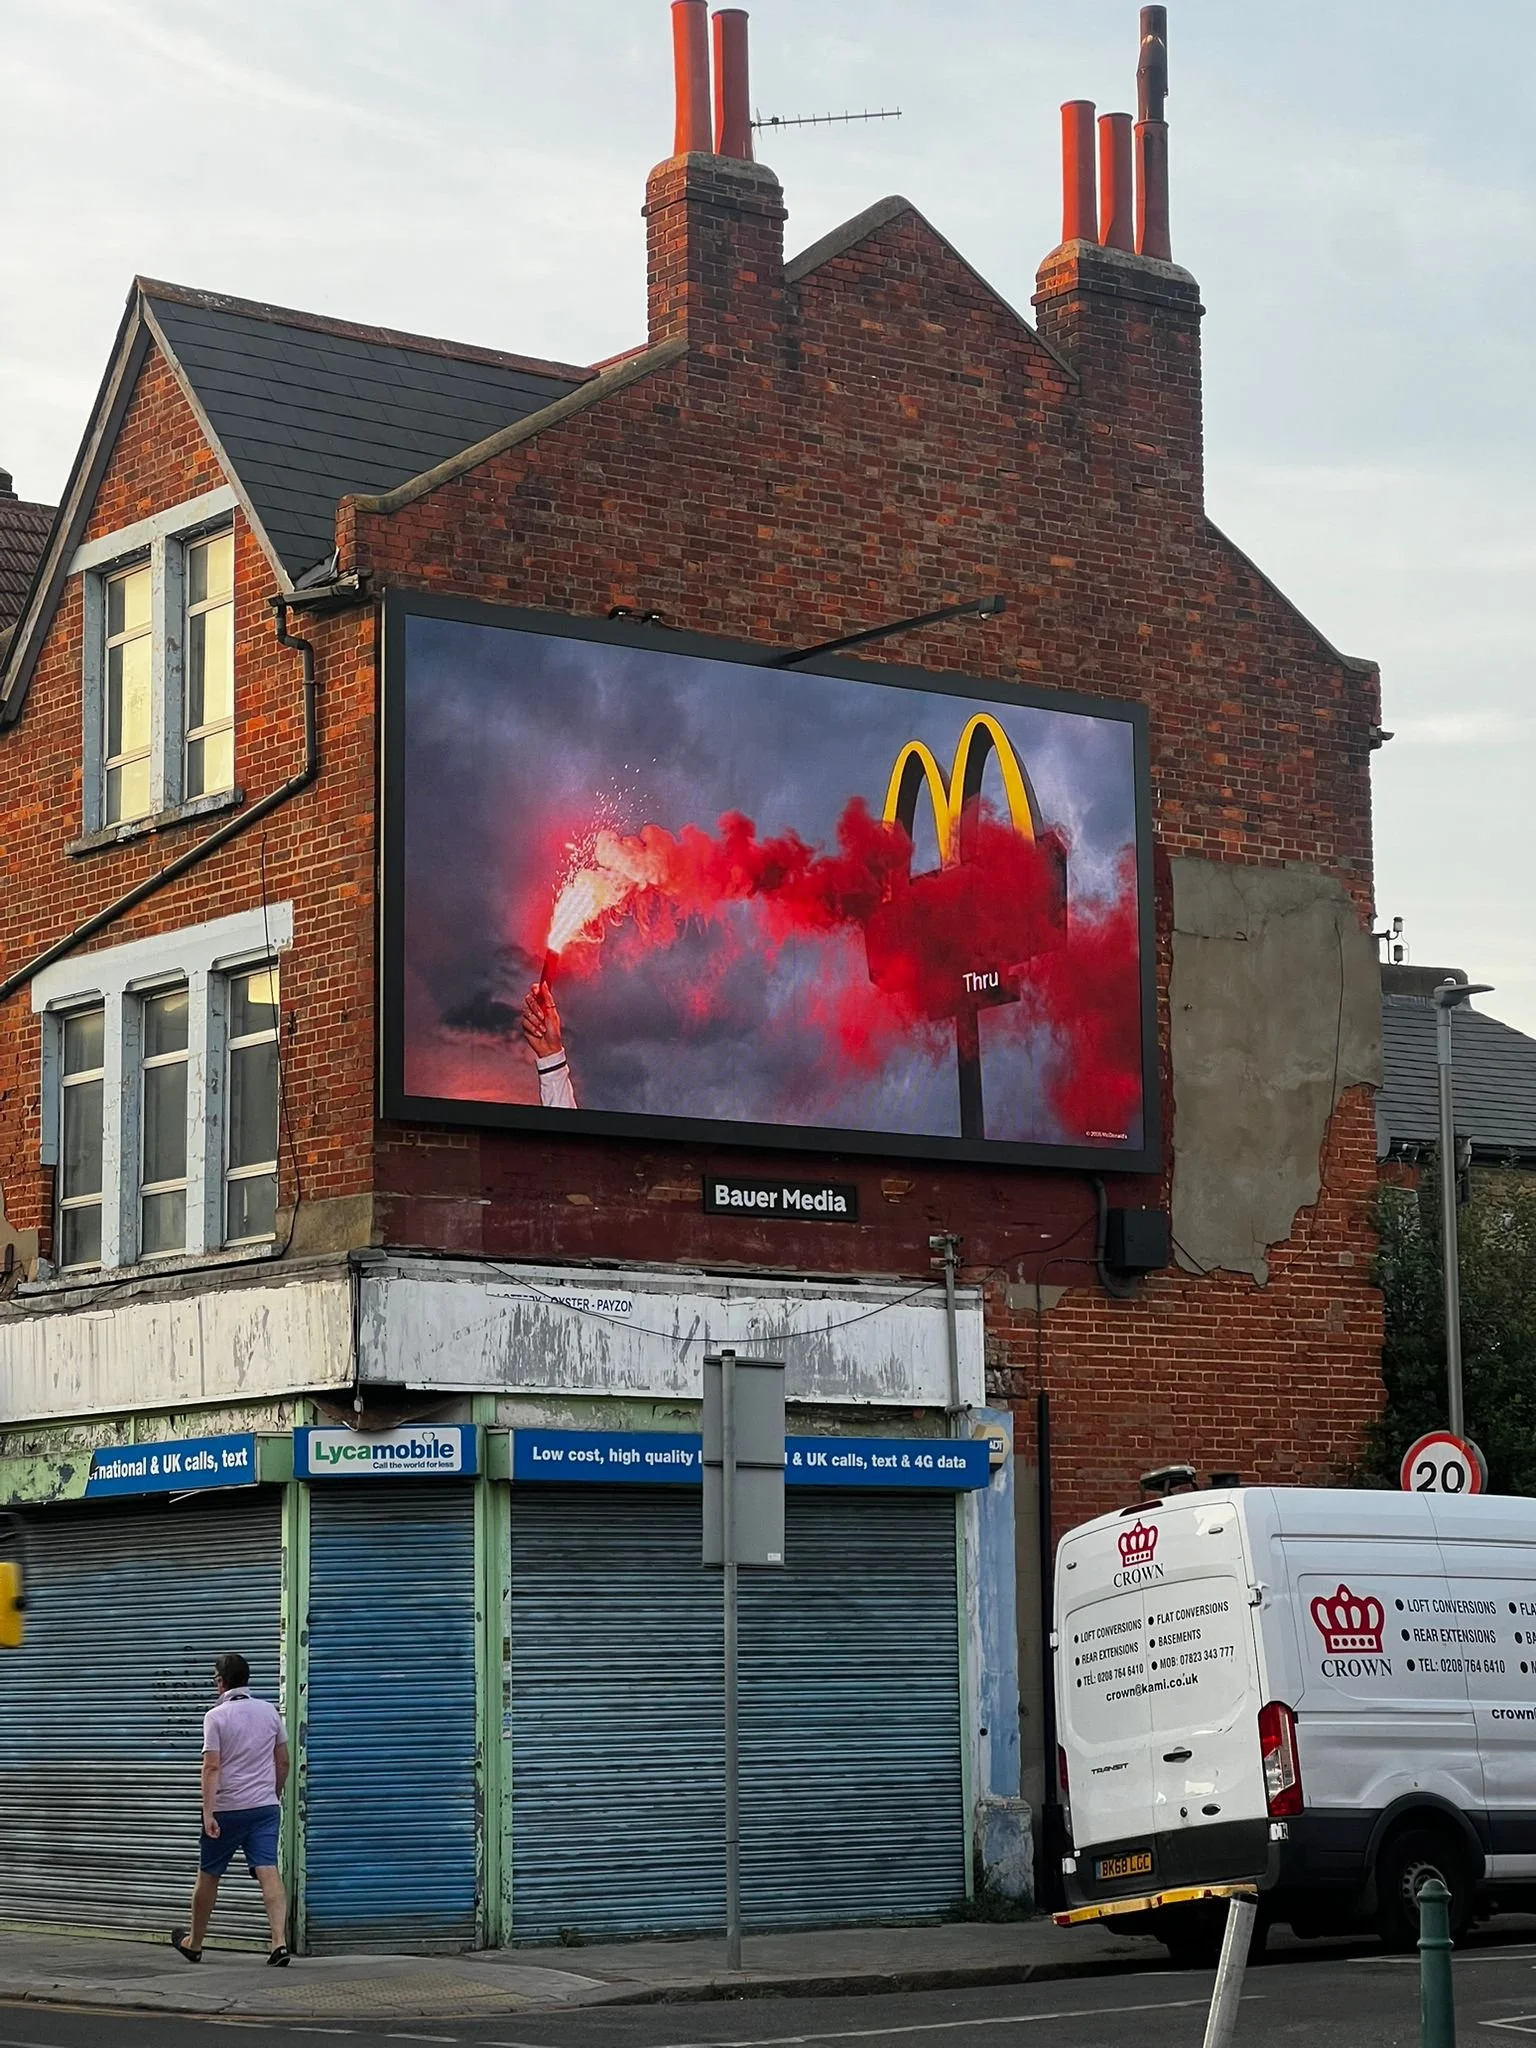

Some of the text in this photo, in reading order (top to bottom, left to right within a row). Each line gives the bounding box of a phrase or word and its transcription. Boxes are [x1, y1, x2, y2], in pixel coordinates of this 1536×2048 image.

[962, 971, 999, 992] Thru
[715, 1184, 847, 1212] Bauer Media
[150, 1455, 160, 1475] &
[162, 1453, 182, 1474] UK
[184, 1450, 218, 1473] calls,
[222, 1447, 248, 1468] text
[315, 1438, 454, 1464] Lycamobile
[532, 1446, 563, 1461] Low
[568, 1448, 605, 1465] cost,
[609, 1448, 640, 1465] high
[645, 1449, 694, 1467] quality
[792, 1452, 803, 1466] &
[806, 1453, 828, 1466] UK
[831, 1453, 868, 1470] calls,
[871, 1454, 898, 1468] text
[901, 1454, 911, 1468] &
[914, 1455, 933, 1468] 4G
[937, 1455, 966, 1469] data
[372, 1461, 388, 1469] Call
[389, 1461, 402, 1469] the
[403, 1461, 425, 1469] world
[1416, 1461, 1465, 1493] 20
[1113, 1563, 1164, 1588] CROWN
[1157, 1601, 1229, 1625] FLAT CONVERSIONS
[1407, 1599, 1497, 1614] LOFT CONVERSIONS
[1080, 1619, 1142, 1643] LOFT CONVERSIONS
[1158, 1629, 1201, 1647] BASEMENTS
[1413, 1628, 1496, 1643] REAR EXTENSIONS
[1081, 1642, 1139, 1665] REAR EXTENSIONS
[1160, 1645, 1234, 1669] MOB: 07823 343 777
[1083, 1663, 1144, 1686] TEL: 0208 764 6410
[1321, 1658, 1392, 1678] CROWN
[1418, 1658, 1505, 1673] TEL: 0208 764 6410
[1106, 1673, 1198, 1701] crown@kami.co.uk
[1491, 1707, 1536, 1720] crown
[1091, 1762, 1129, 1775] TRANSIT
[1102, 1854, 1150, 1876] BK68 LGC
